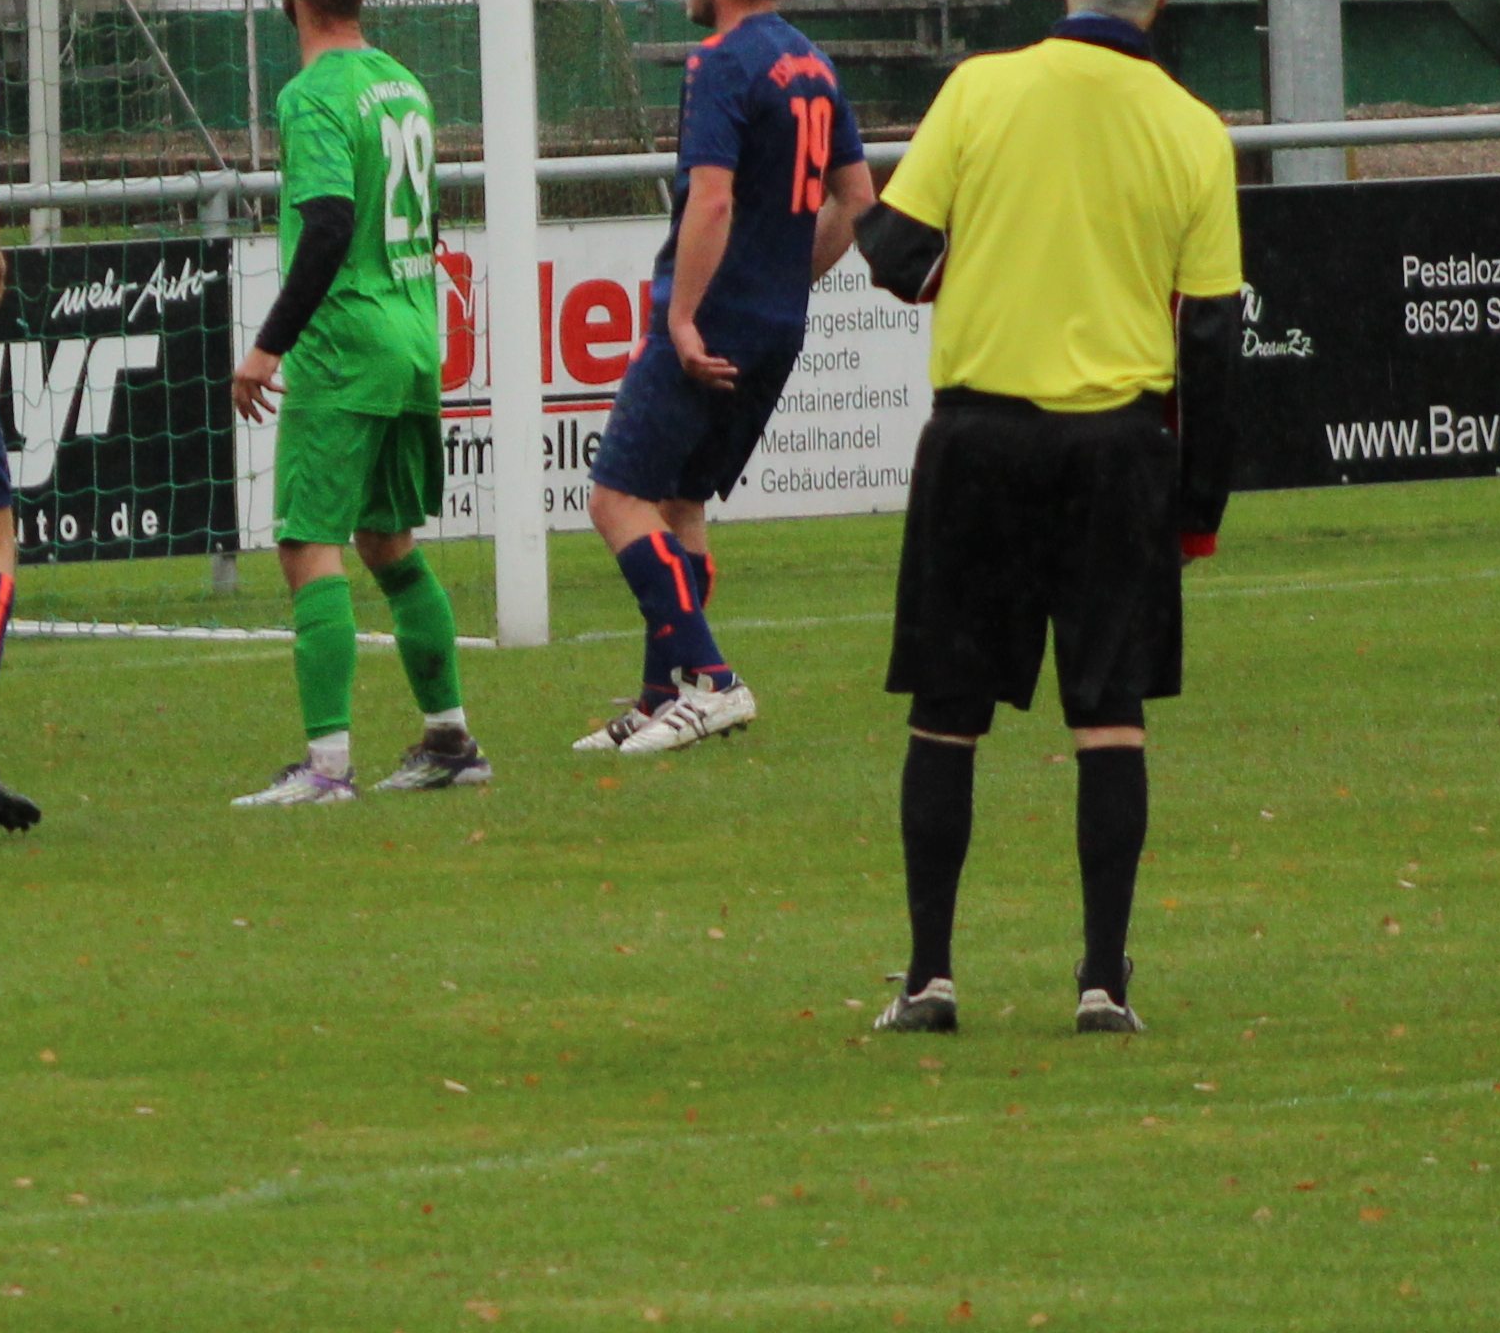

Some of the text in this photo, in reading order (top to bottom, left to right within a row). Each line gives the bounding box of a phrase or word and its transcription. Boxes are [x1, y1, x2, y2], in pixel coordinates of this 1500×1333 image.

[789, 95, 834, 214] 19
[380, 109, 434, 244] 29
[51, 257, 218, 323] mehr Auto
[1405, 299, 1479, 334] 86529
[775, 384, 909, 414] ontainerdienst
[760, 424, 881, 454] Metallhandel
[761, 466, 914, 494] Gebäuderäumu
